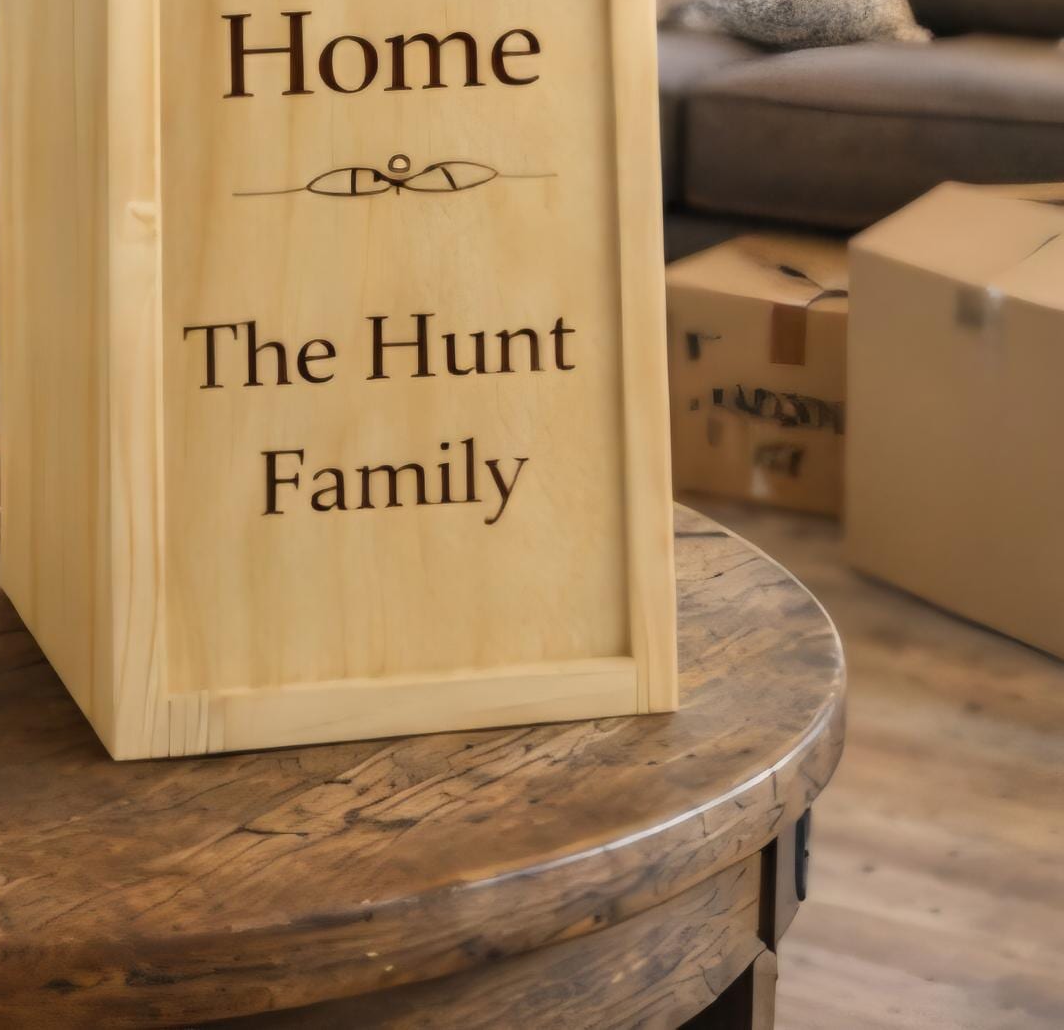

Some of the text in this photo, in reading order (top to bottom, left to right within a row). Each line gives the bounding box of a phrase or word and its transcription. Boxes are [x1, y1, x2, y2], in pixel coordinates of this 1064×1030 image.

[220, 10, 541, 99] Home
[182, 313, 576, 390] The Hunt
[260, 437, 529, 525] Family
